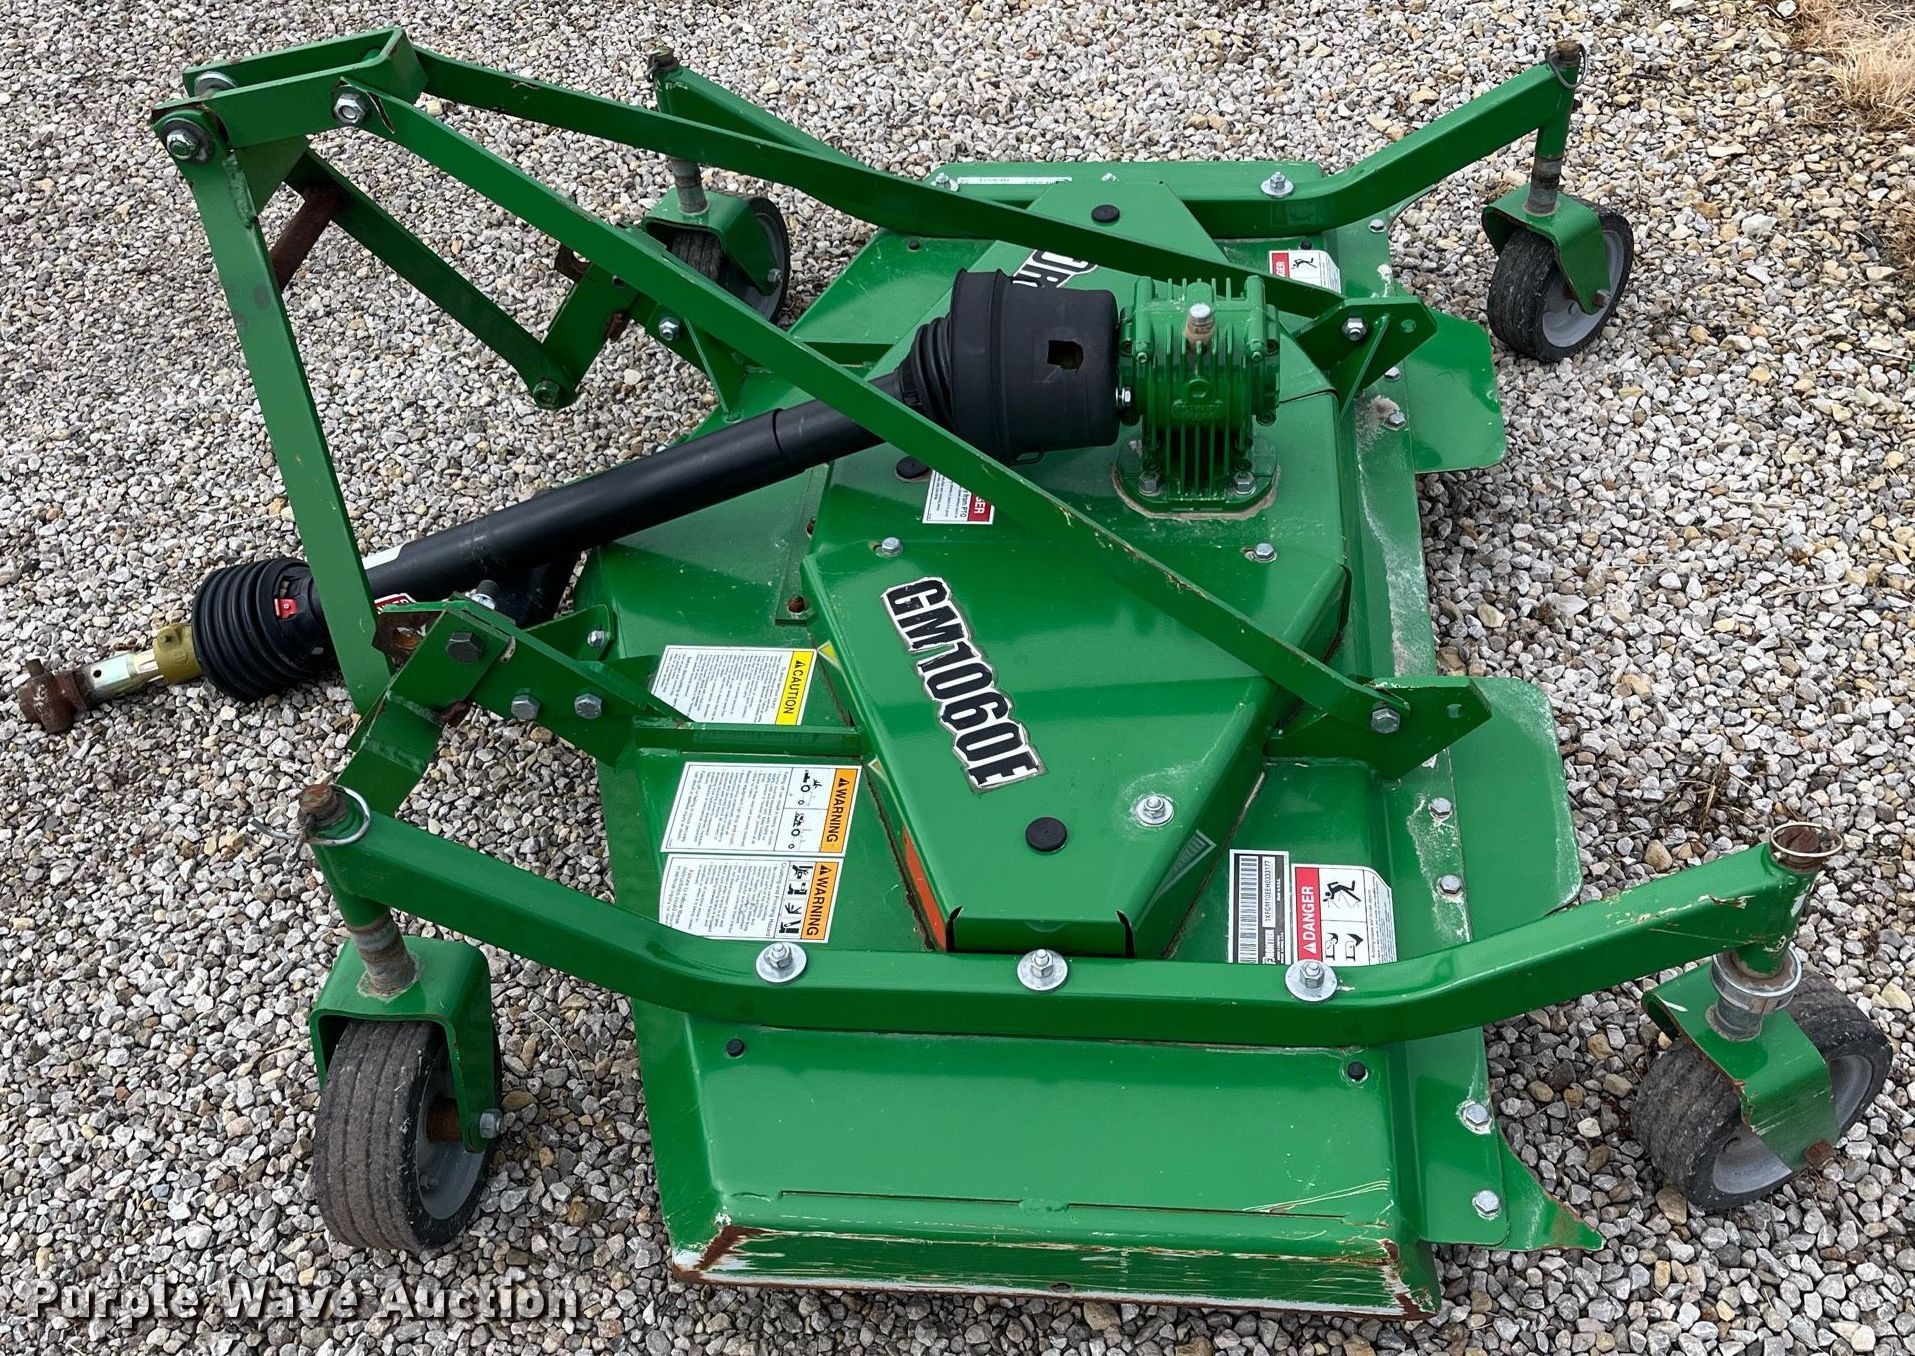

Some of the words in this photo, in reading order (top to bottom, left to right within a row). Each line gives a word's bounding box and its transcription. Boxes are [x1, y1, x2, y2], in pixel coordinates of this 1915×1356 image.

[783, 668, 804, 715] CAUTION
[885, 579, 1040, 787] GM1060E
[827, 787, 847, 843] WARNING
[806, 877, 826, 936] WARNING
[1301, 885, 1315, 941] DANGER
